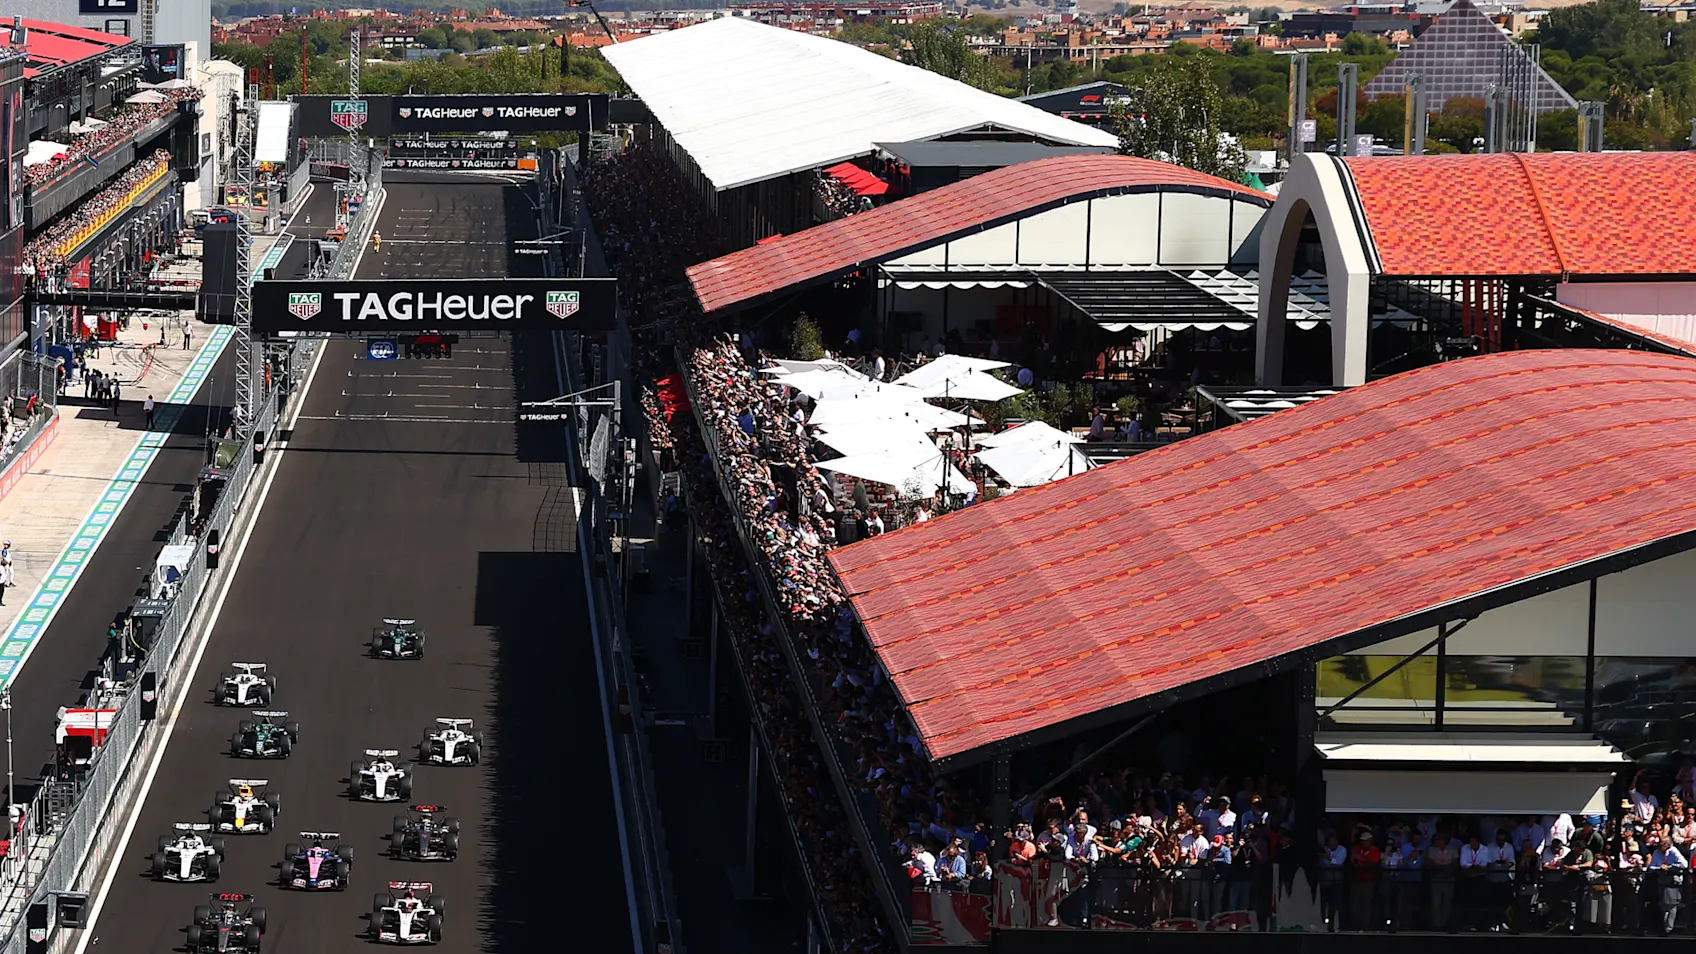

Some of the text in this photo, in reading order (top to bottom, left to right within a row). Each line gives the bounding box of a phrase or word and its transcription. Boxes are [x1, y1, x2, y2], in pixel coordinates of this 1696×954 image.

[414, 106, 561, 119] TAGHeuer TAGHeuer
[291, 294, 318, 304] TAG
[549, 292, 576, 302] TAG
[290, 303, 321, 318] HEUER
[333, 292, 534, 320] TAGHeuer
[547, 303, 578, 317] HEUER
